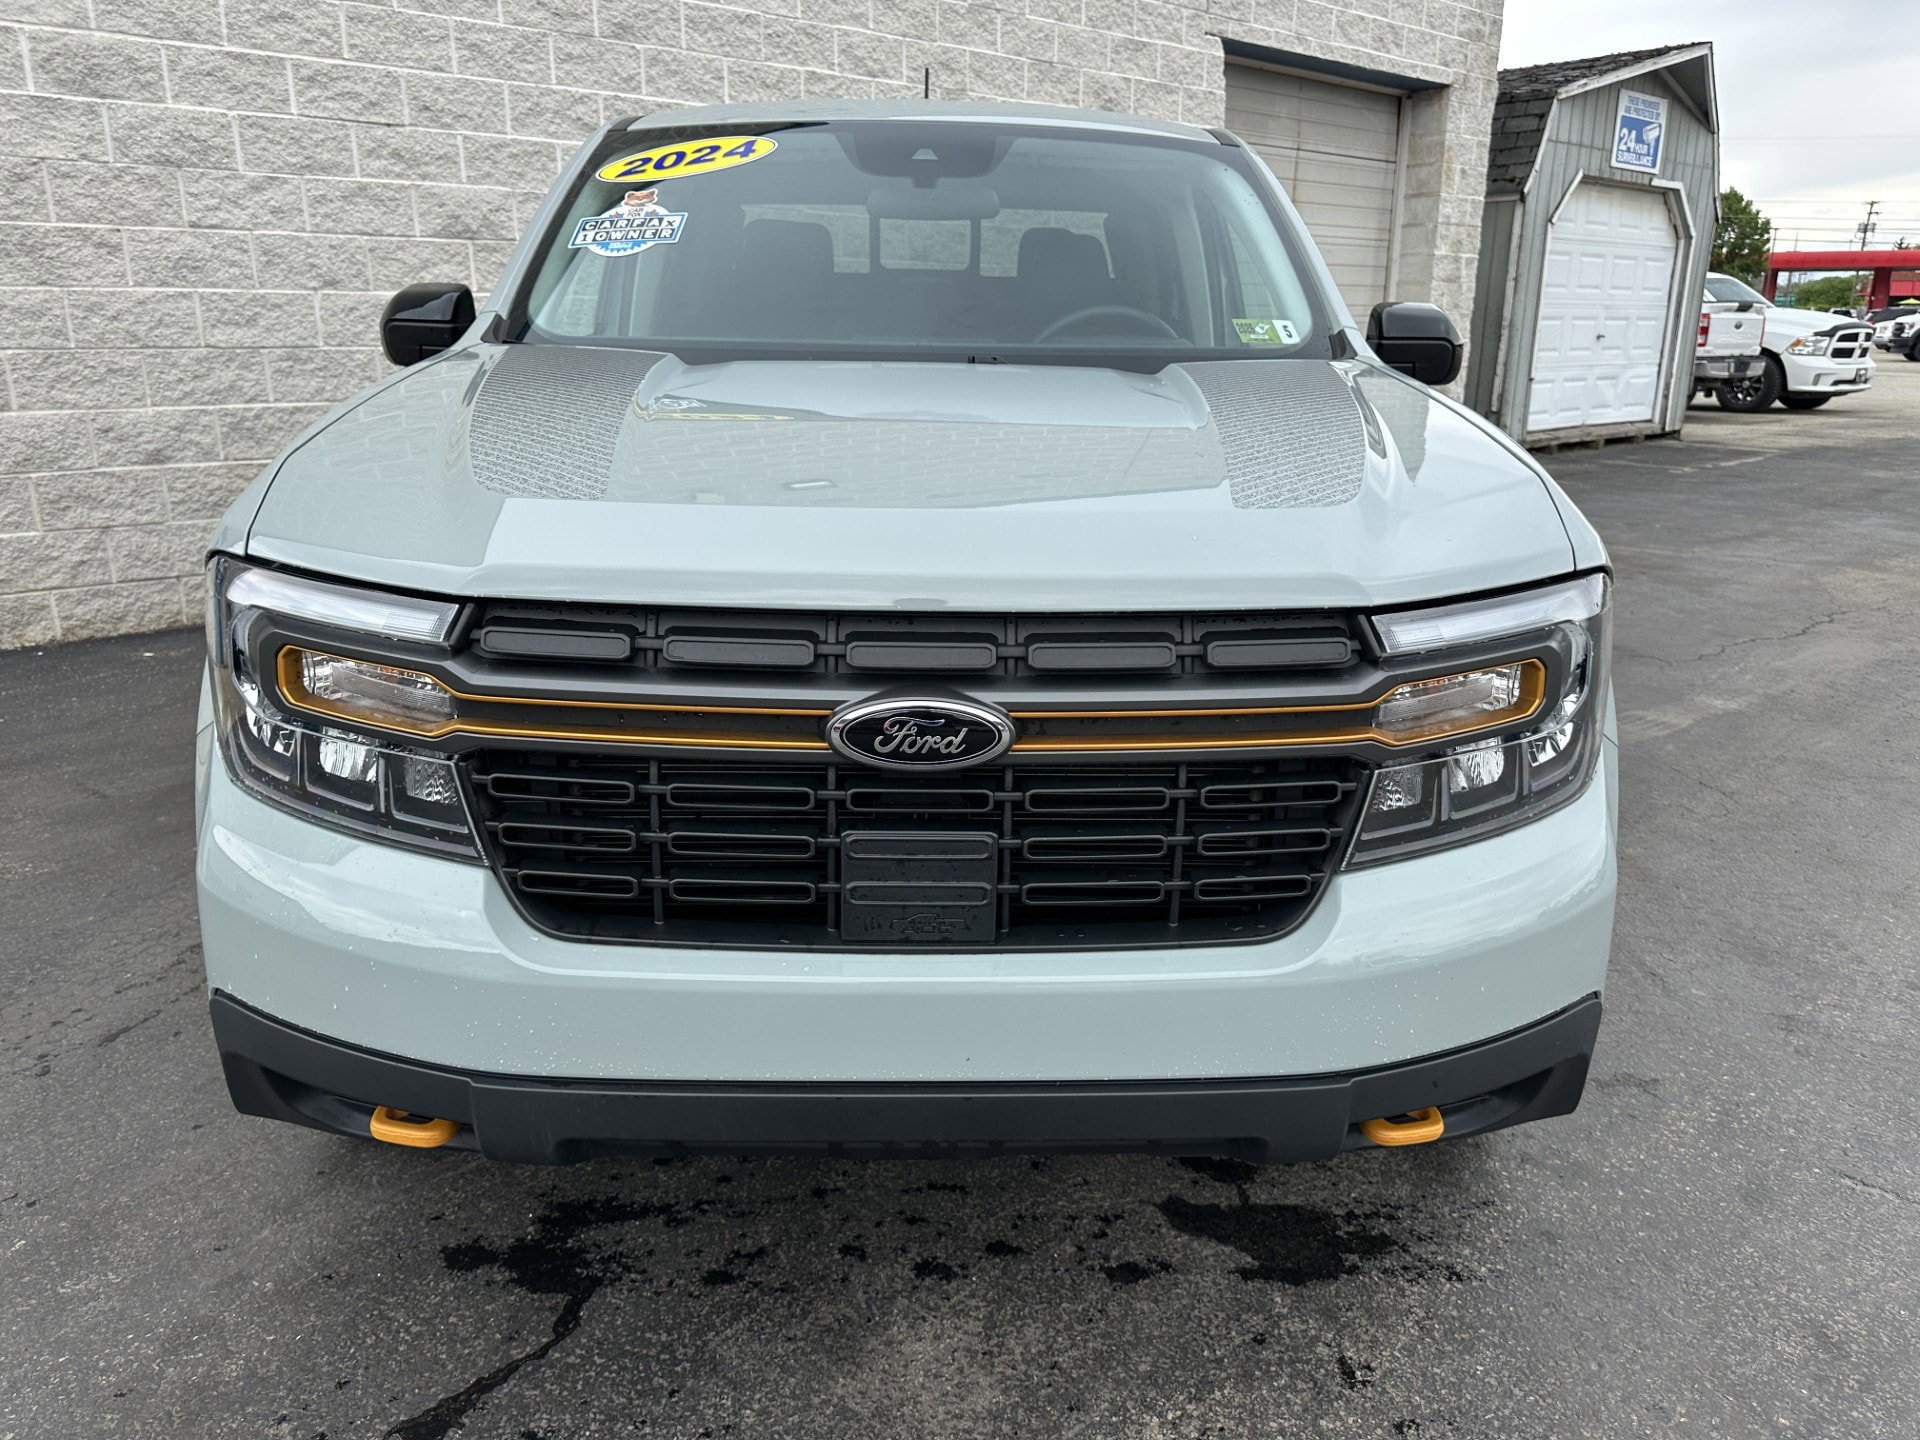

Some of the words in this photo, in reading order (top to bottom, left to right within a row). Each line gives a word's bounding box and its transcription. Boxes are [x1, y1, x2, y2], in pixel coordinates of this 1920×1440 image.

[1619, 127, 1637, 152] 24
[614, 139, 758, 178] 2024
[583, 218, 678, 231] CARFAX
[580, 233, 589, 242] 1
[594, 229, 674, 241] OWNER
[1282, 325, 1293, 338] 5
[873, 716, 969, 754] Ford
